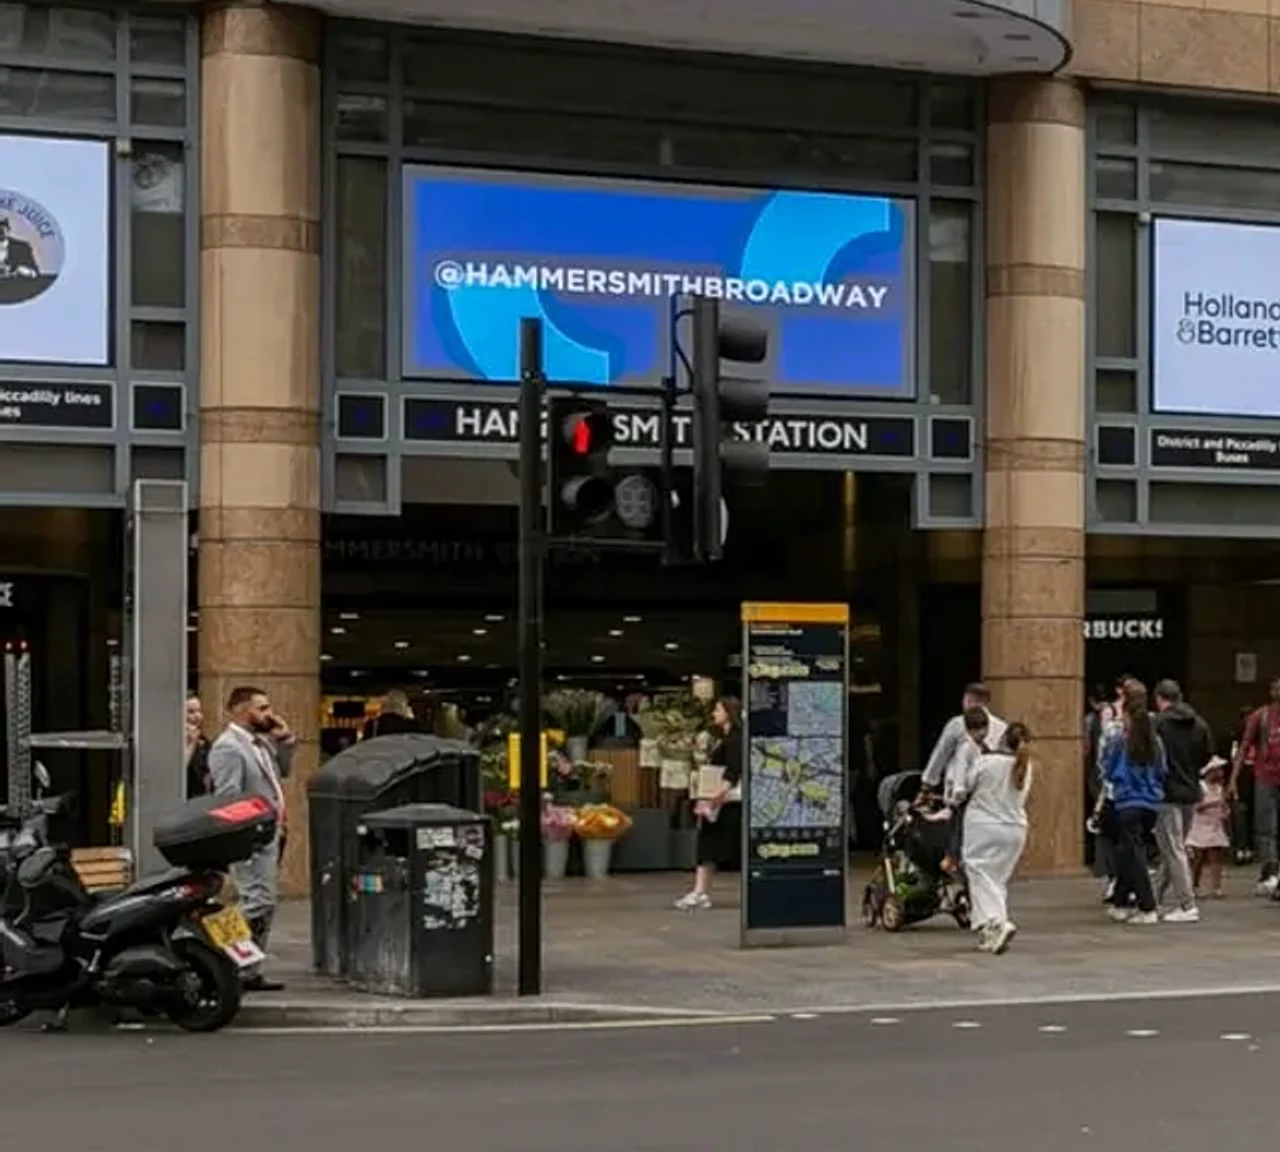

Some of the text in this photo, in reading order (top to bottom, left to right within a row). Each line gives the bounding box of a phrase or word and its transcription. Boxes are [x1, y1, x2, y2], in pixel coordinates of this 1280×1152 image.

[434, 260, 888, 309] @HAMMERSMITHBROADWAY
[0, 389, 102, 407] iccadilly lines
[1157, 434, 1200, 449] District
[1203, 436, 1224, 449] and
[1226, 437, 1277, 453] Piccadilly
[1216, 450, 1249, 463] Buses
